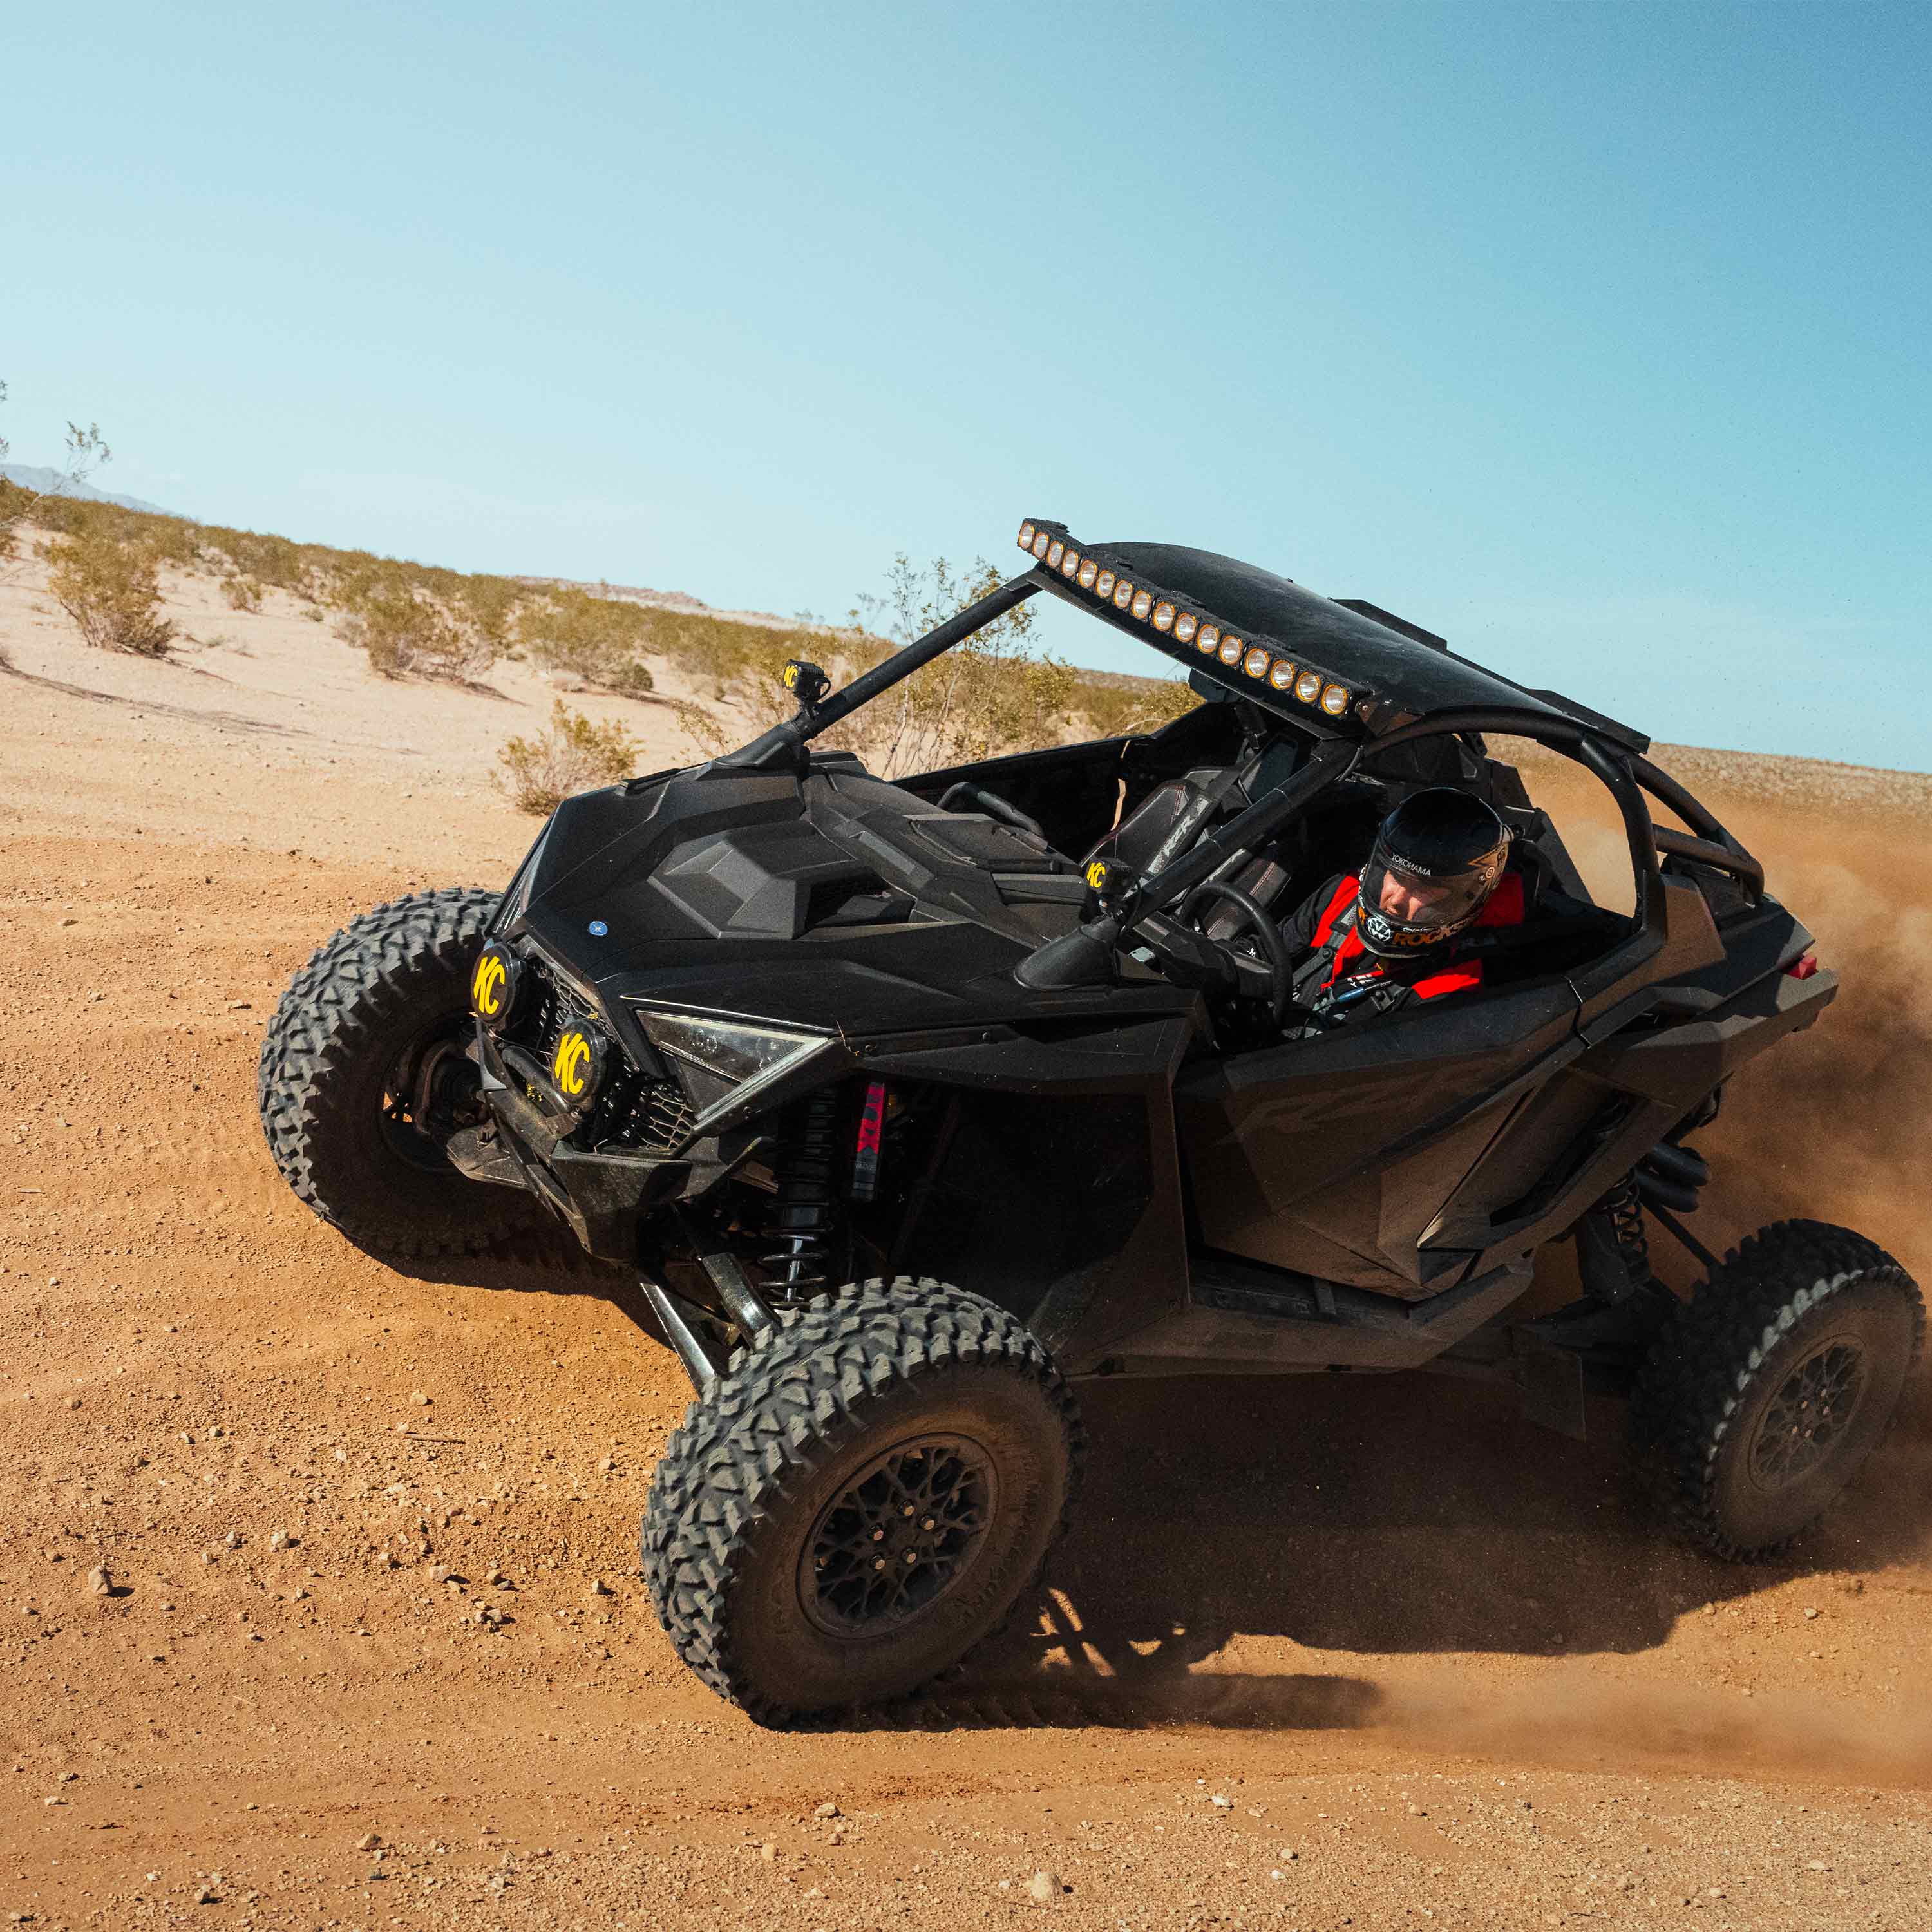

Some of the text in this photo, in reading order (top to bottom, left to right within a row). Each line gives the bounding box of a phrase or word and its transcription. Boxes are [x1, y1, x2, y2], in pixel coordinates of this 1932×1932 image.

[784, 665, 798, 688] KC
[1086, 862, 1106, 888] KC
[1391, 851, 1431, 876] YOKOHAMA
[473, 955, 506, 1015] KC
[553, 1032, 591, 1095] KC
